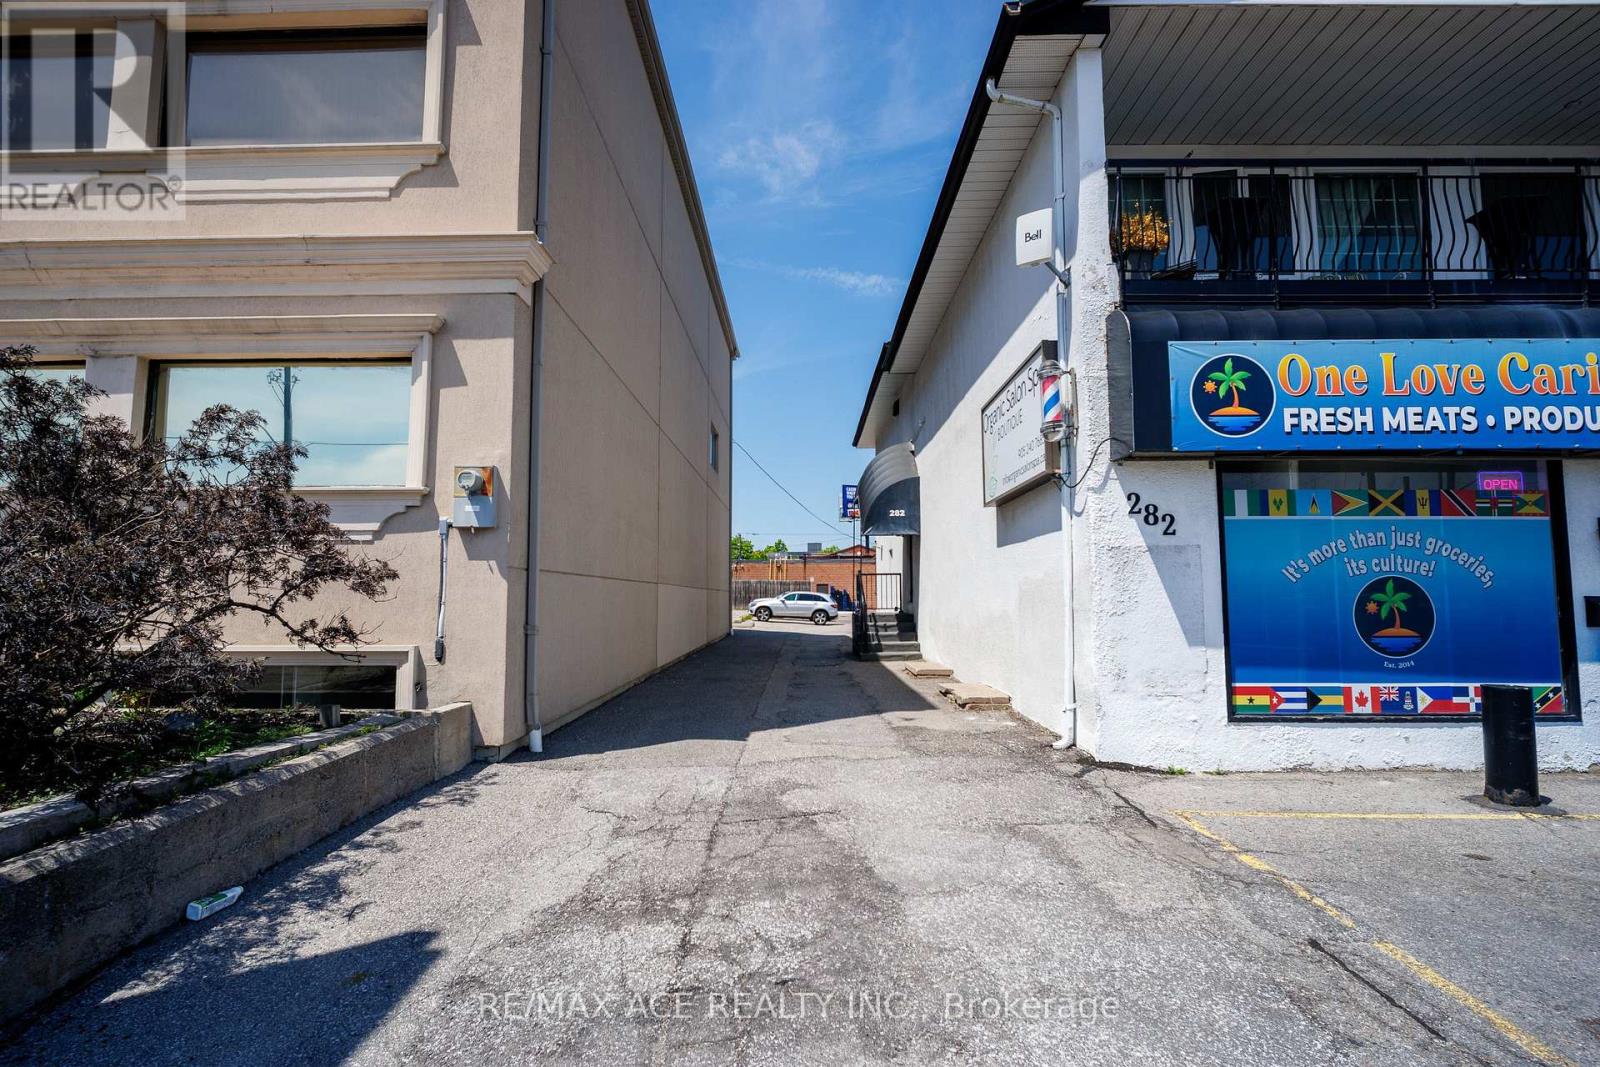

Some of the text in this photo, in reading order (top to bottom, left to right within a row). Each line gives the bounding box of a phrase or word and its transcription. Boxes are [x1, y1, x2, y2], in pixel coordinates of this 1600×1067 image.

[1025, 229, 1042, 243] Bell
[1277, 352, 1600, 396] One Love Cari
[984, 366, 1042, 435] Organic Salon Sp
[1283, 405, 1600, 433] FRESH MEATS PRODU
[1483, 479, 1518, 490] OPEN
[889, 509, 905, 517] 282
[1126, 492, 1176, 536] 282
[1281, 525, 1494, 588] It's more than just groceries,
[1344, 553, 1436, 577] its culture!
